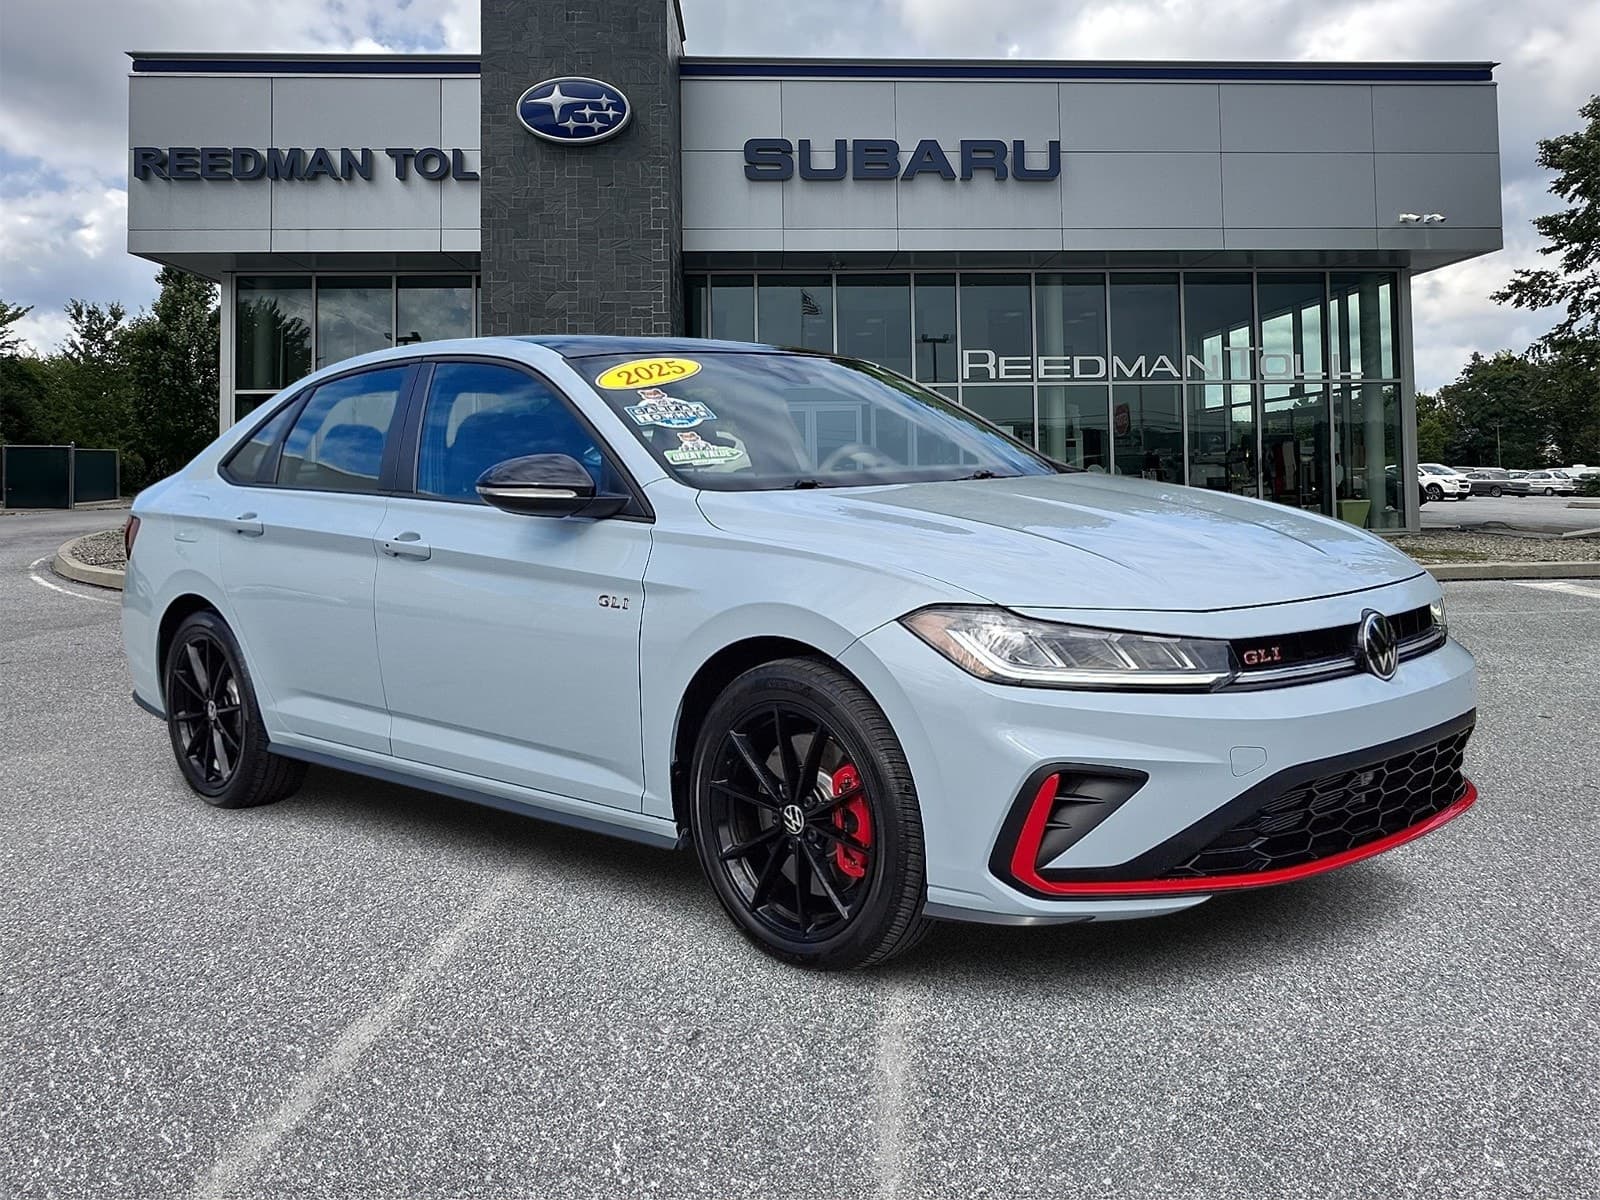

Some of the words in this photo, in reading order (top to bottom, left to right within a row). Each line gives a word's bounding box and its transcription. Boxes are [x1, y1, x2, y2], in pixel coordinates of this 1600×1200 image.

[133, 147, 372, 181] REEDMAN
[385, 147, 480, 181] TOL
[744, 138, 1061, 181] SUBARU
[617, 361, 685, 386] 2025
[598, 594, 629, 610] GLI
[1243, 646, 1281, 665] GLI
